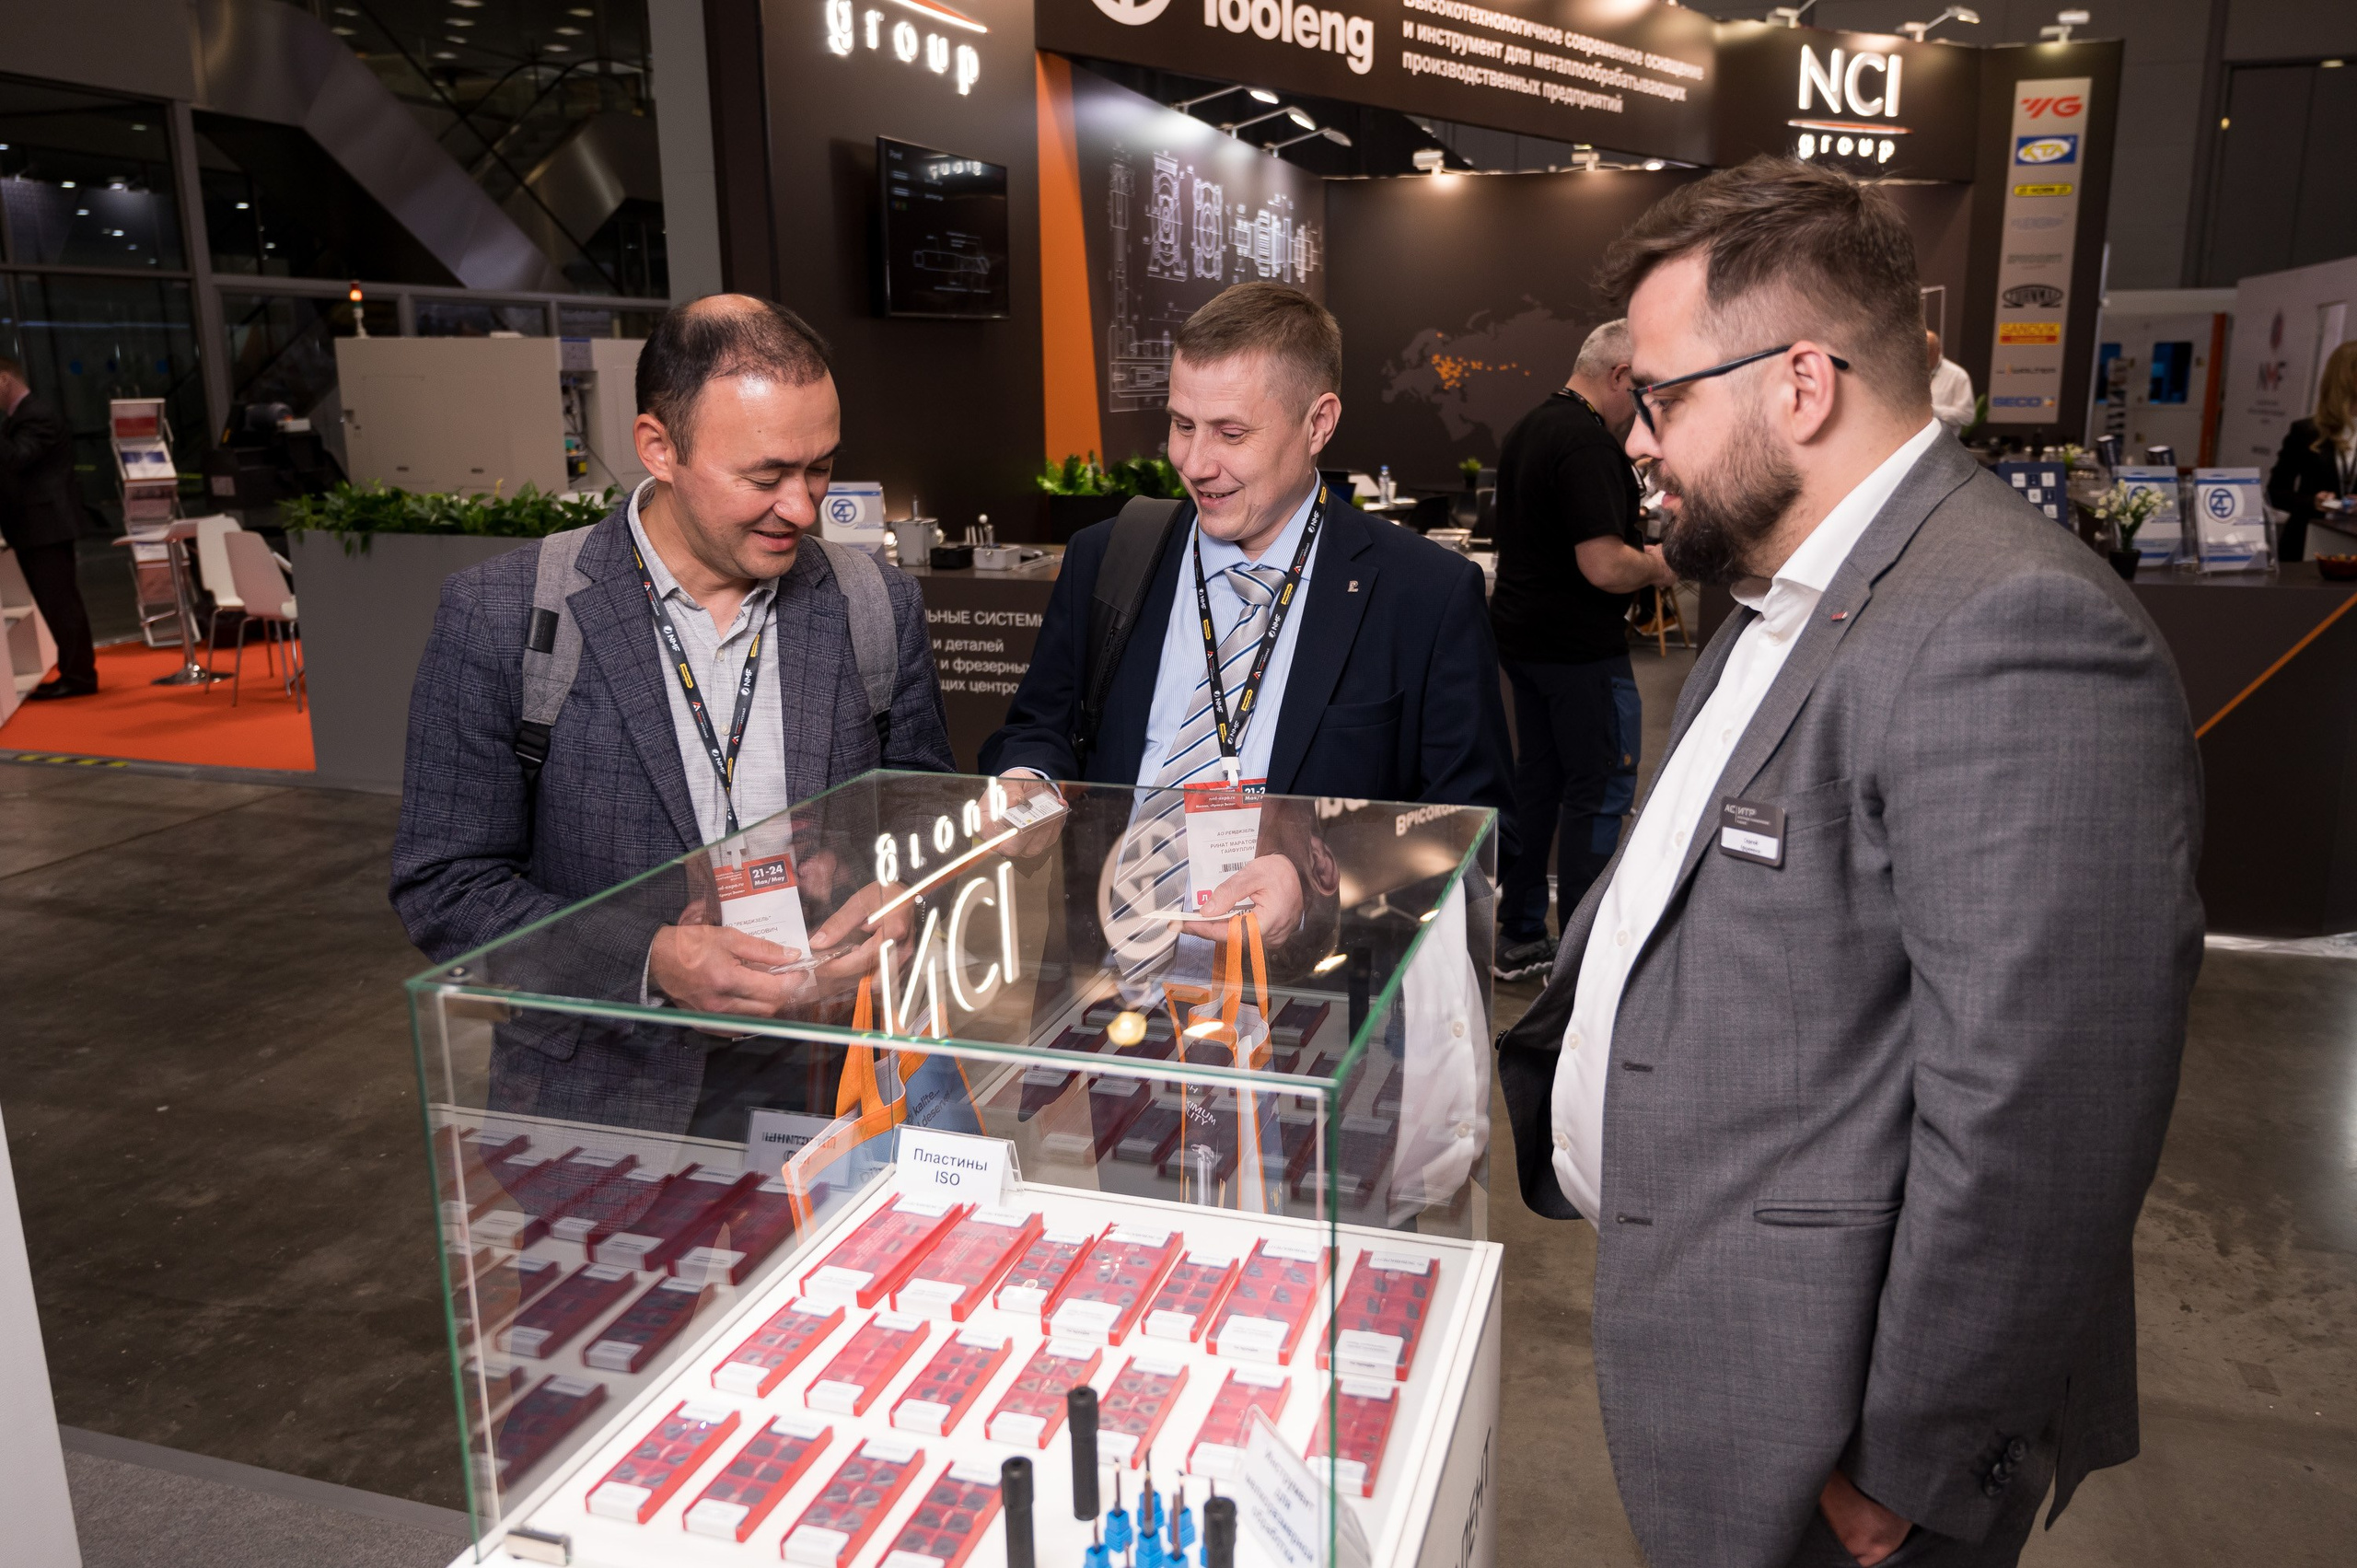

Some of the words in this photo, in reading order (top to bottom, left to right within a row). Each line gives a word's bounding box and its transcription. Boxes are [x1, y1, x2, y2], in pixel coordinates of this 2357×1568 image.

[826, 0, 980, 96] group
[1402, 20, 1413, 39] и
[1417, 23, 1504, 57] инструмент
[1504, 45, 1532, 66] для
[1564, 30, 1643, 66] современное
[1402, 51, 1541, 99] производственных
[1542, 82, 1623, 113] предприятий
[1798, 44, 1903, 118] NCI
[1798, 133, 1896, 164] group
[1271, 614, 1282, 631] NMF
[668, 633, 680, 652] NMF
[933, 640, 942, 649] и
[945, 639, 1004, 653] деталей
[940, 659, 949, 669] и
[744, 668, 753, 687] NMF
[1230, 720, 1240, 738] NMF
[752, 865, 784, 878] 21-24
[913, 1147, 988, 1170] Пластины
[935, 1170, 960, 1185] ISO
